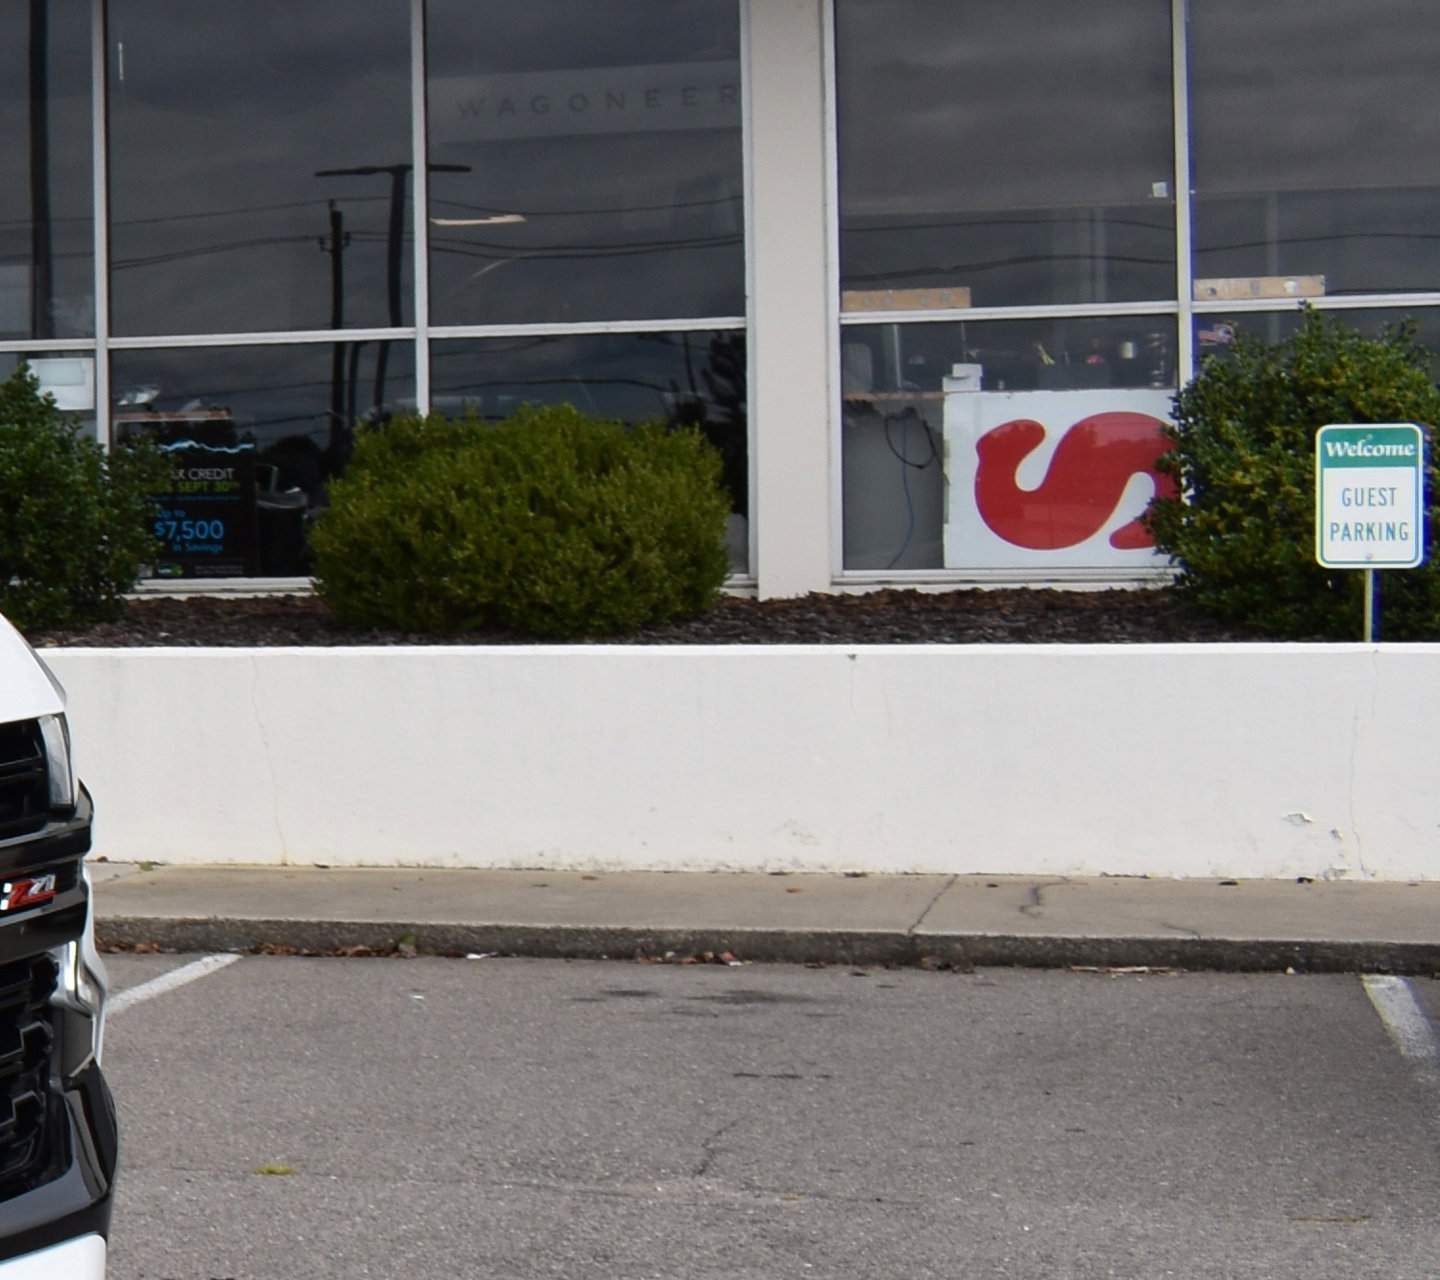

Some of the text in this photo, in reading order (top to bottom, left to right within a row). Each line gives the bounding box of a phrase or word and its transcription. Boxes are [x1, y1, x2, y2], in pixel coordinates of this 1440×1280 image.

[457, 83, 737, 120] WAGONEER
[1324, 439, 1416, 457] Welcome
[188, 468, 234, 480] CREDIT
[178, 481, 209, 492] SEPT
[1341, 487, 1398, 508] GUEST
[154, 520, 224, 541] $7,500
[1330, 522, 1409, 541] PARKING
